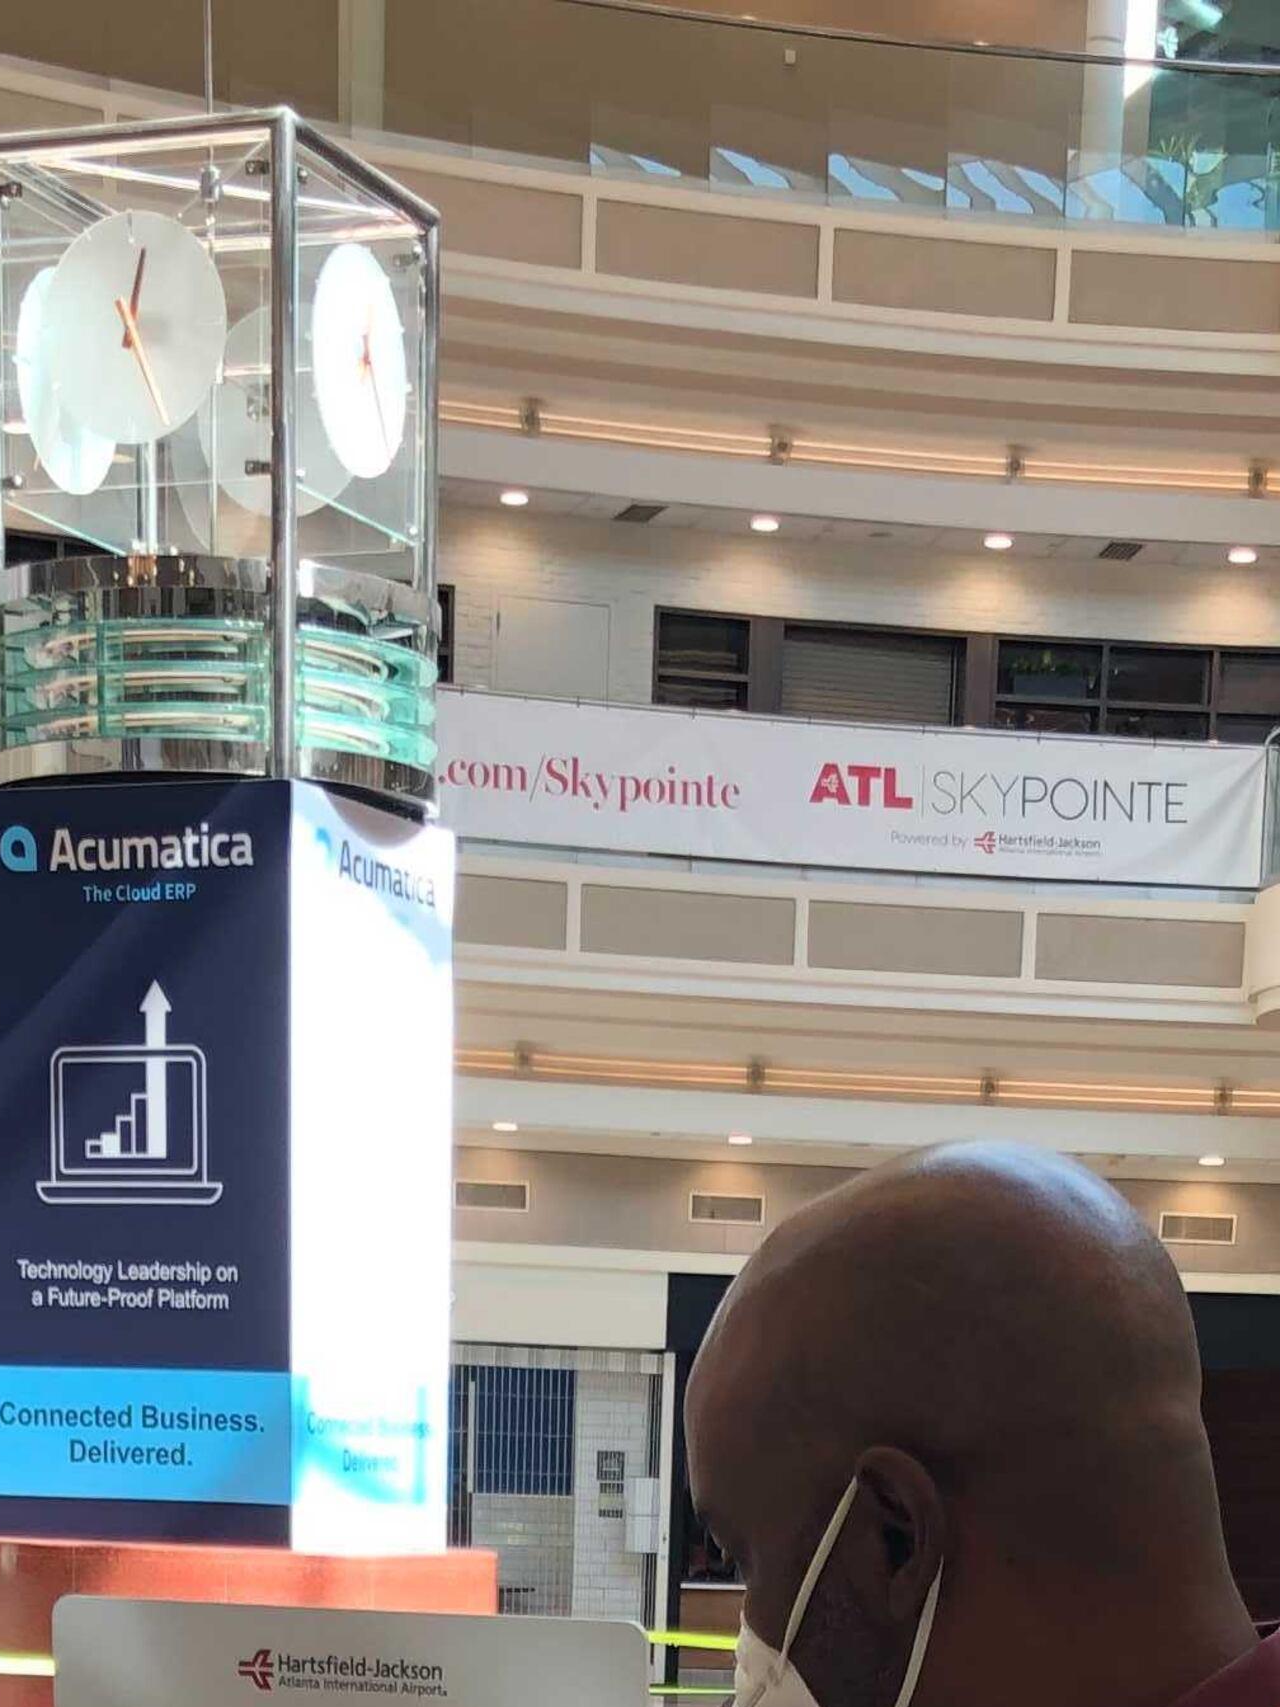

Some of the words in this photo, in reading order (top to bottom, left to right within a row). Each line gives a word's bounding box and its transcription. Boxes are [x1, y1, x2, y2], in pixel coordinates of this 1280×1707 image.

[809, 762, 914, 810] ATL
[932, 770, 1189, 825] SKYPOINTE
[48, 822, 254, 872] Acumatica
[890, 830, 949, 847] Powered
[952, 832, 968, 850] by
[998, 833, 1101, 850] Hartsfield-Jackson
[82, 885, 113, 903] The
[116, 883, 161, 902] Cloud
[164, 883, 197, 901] ERP
[17, 1258, 113, 1285] Technology
[117, 1260, 211, 1286] Leadership
[216, 1266, 239, 1283] on
[31, 1291, 43, 1307] a
[48, 1287, 154, 1309] Future-Proof
[157, 1288, 230, 1311] Platform
[140, 1405, 266, 1434] Business.
[69, 1439, 194, 1468] Delivered.
[277, 1653, 443, 1681] Hartsfield-Jackson
[278, 1675, 320, 1690] Atlanta
[323, 1678, 398, 1694] International
